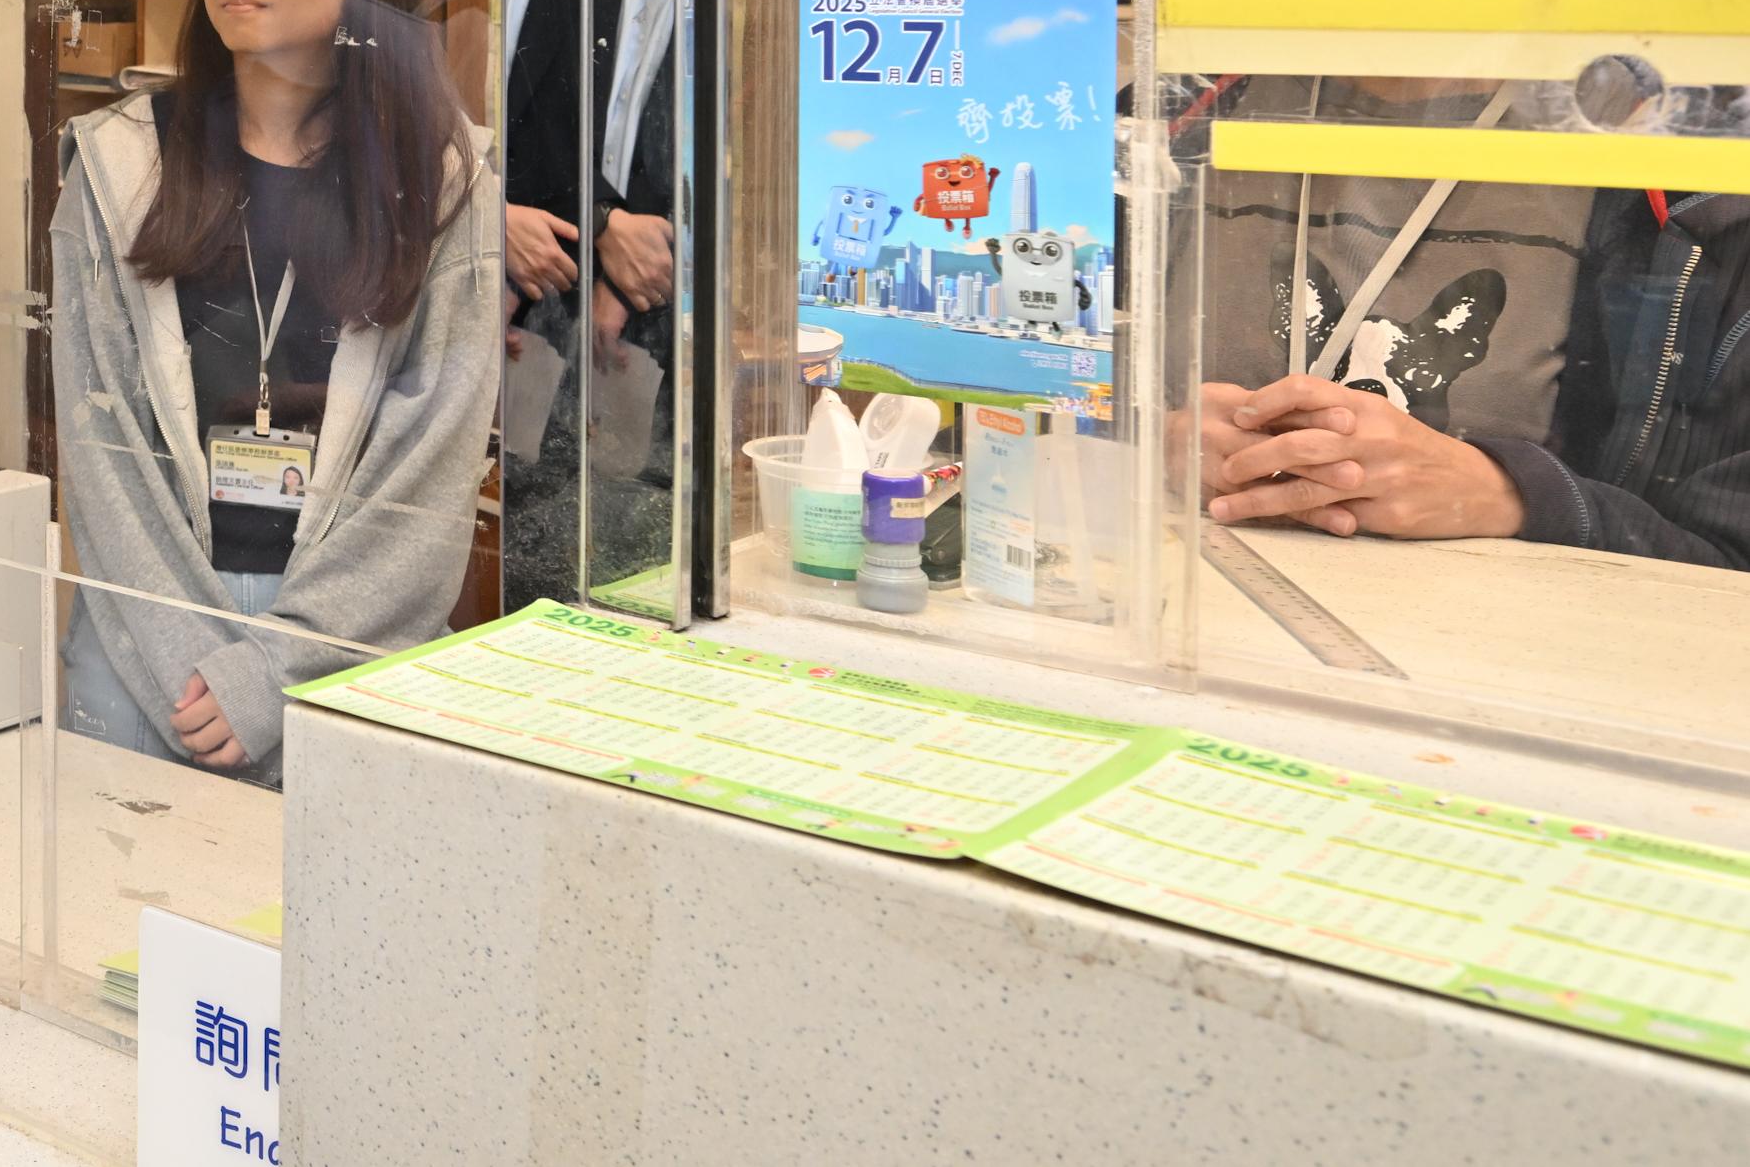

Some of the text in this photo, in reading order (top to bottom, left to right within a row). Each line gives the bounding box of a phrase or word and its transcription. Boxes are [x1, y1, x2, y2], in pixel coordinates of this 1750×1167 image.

[937, 190, 975, 204] 投票箱
[1019, 290, 1057, 305] 投票箱
[545, 606, 637, 640] 2025
[1186, 738, 1310, 780] 2025
